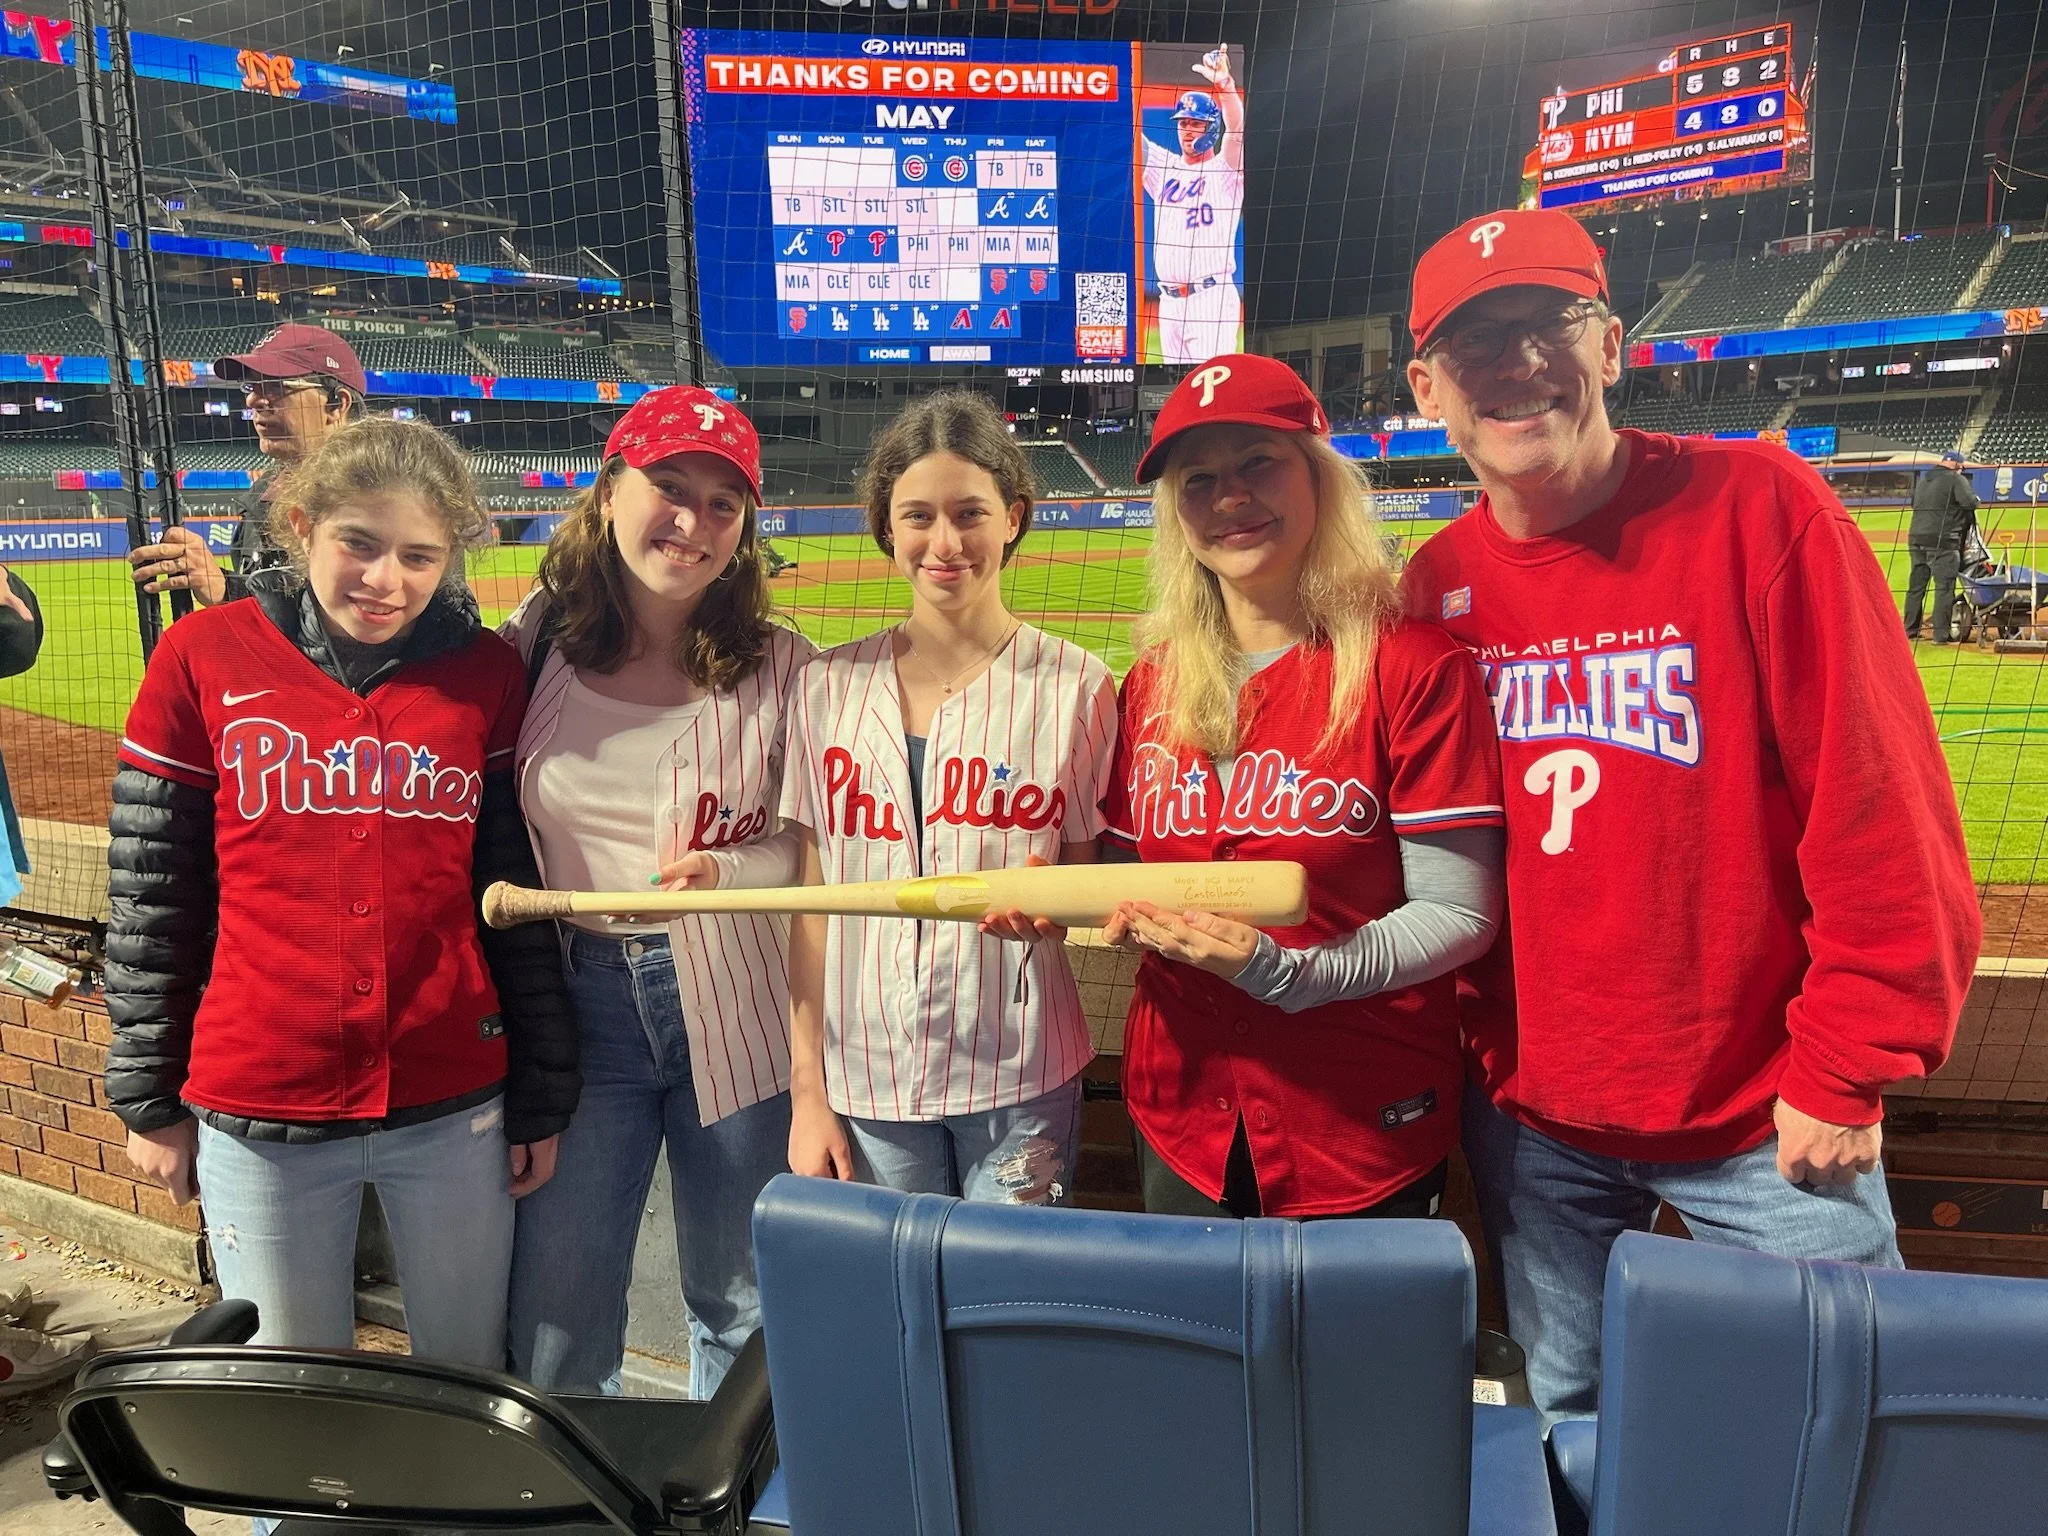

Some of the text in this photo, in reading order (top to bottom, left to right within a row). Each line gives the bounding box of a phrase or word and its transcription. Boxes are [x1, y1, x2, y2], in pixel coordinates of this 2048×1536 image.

[893, 41, 965, 56] HYUNDAI
[1689, 32, 1775, 60] R H E
[711, 61, 1110, 95] THANKS FOR COMING
[1586, 88, 1623, 118] PHI
[1686, 74, 1704, 94] 5
[1722, 67, 1740, 87] 8
[1759, 60, 1777, 80] 2
[876, 105, 955, 129] MAY
[1585, 121, 1634, 152] NYM
[1684, 112, 1702, 130] 4
[1721, 105, 1738, 124] 8
[1758, 98, 1776, 117] 0
[777, 135, 801, 143] SUN
[818, 136, 845, 144] MON
[902, 137, 927, 145] WED
[944, 138, 967, 146] THU
[987, 139, 1004, 147] FRI
[1025, 139, 1046, 147] SAT
[988, 163, 1003, 176] TB
[1029, 163, 1043, 176] TB
[1602, 166, 1714, 193] THANKS FOR COMING
[785, 198, 800, 212] TB
[824, 198, 846, 212] STL
[865, 199, 887, 212] STL
[906, 199, 928, 213] STL
[1186, 203, 1214, 228] 20
[908, 237, 928, 251] PHI
[949, 237, 968, 251] PHI
[987, 237, 1010, 251] MIA
[1026, 237, 1049, 251] MIA
[1469, 221, 1505, 258] P
[785, 275, 810, 288] MIA
[827, 275, 849, 288] CLE
[868, 275, 890, 288] CLE
[909, 275, 930, 289] CLE
[321, 318, 405, 334] THE PORCH
[1079, 329, 1122, 338] SINGLE
[1079, 347, 1124, 355] TICKETS
[1080, 337, 1123, 347] GAME
[870, 348, 977, 359] HOME AWAY
[1028, 368, 1041, 377] PM
[1061, 369, 1134, 383] SAMSUNG
[1191, 365, 1231, 407] P
[692, 404, 725, 431] P
[1376, 494, 1430, 505] CAESARS
[762, 514, 785, 532] citi
[1125, 517, 1153, 527] GROUP
[0, 531, 102, 549] HYUNDAI
[1476, 643, 1702, 769] HILLIES
[222, 717, 482, 822] Phillies
[1131, 742, 1380, 841] Phillies
[1524, 749, 1600, 855] P
